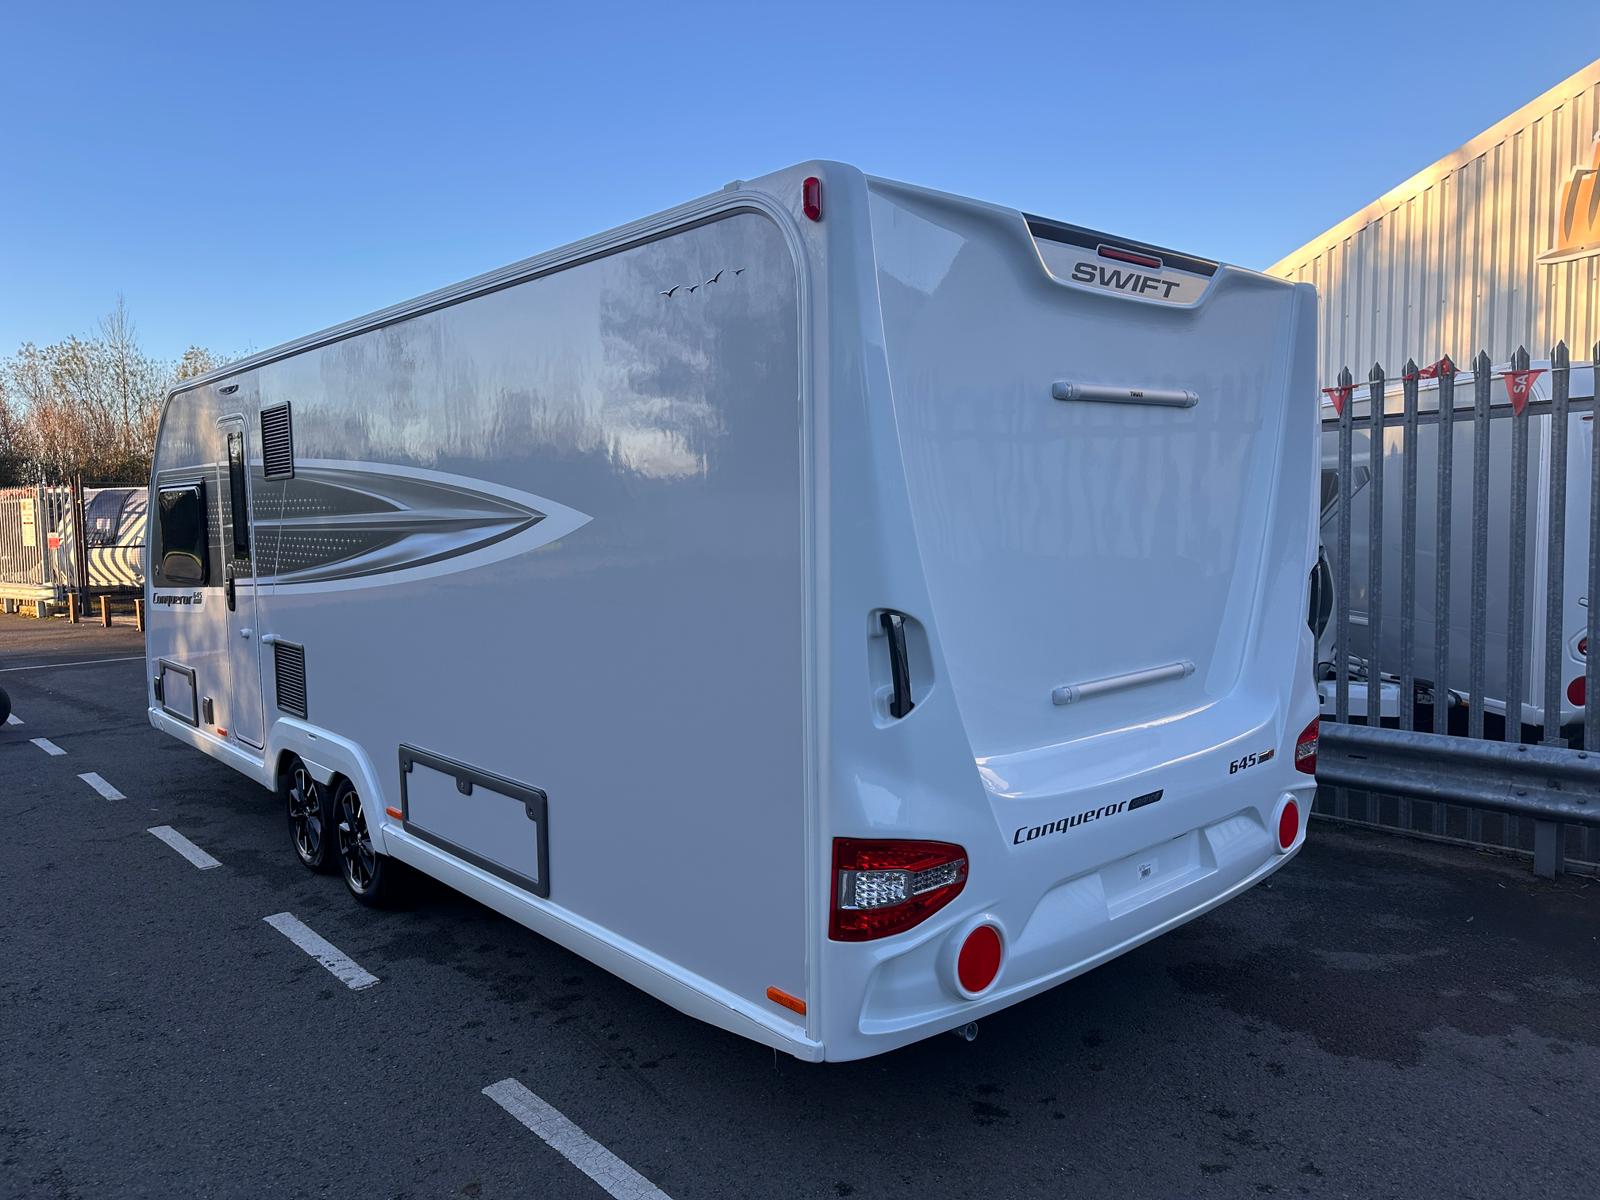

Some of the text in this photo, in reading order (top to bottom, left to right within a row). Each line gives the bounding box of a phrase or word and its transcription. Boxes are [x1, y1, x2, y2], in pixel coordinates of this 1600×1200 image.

[1071, 262, 1180, 298] SWIFT
[153, 592, 192, 607] Conqueror
[1229, 752, 1256, 775] 645
[1013, 800, 1127, 845] Conqueror
